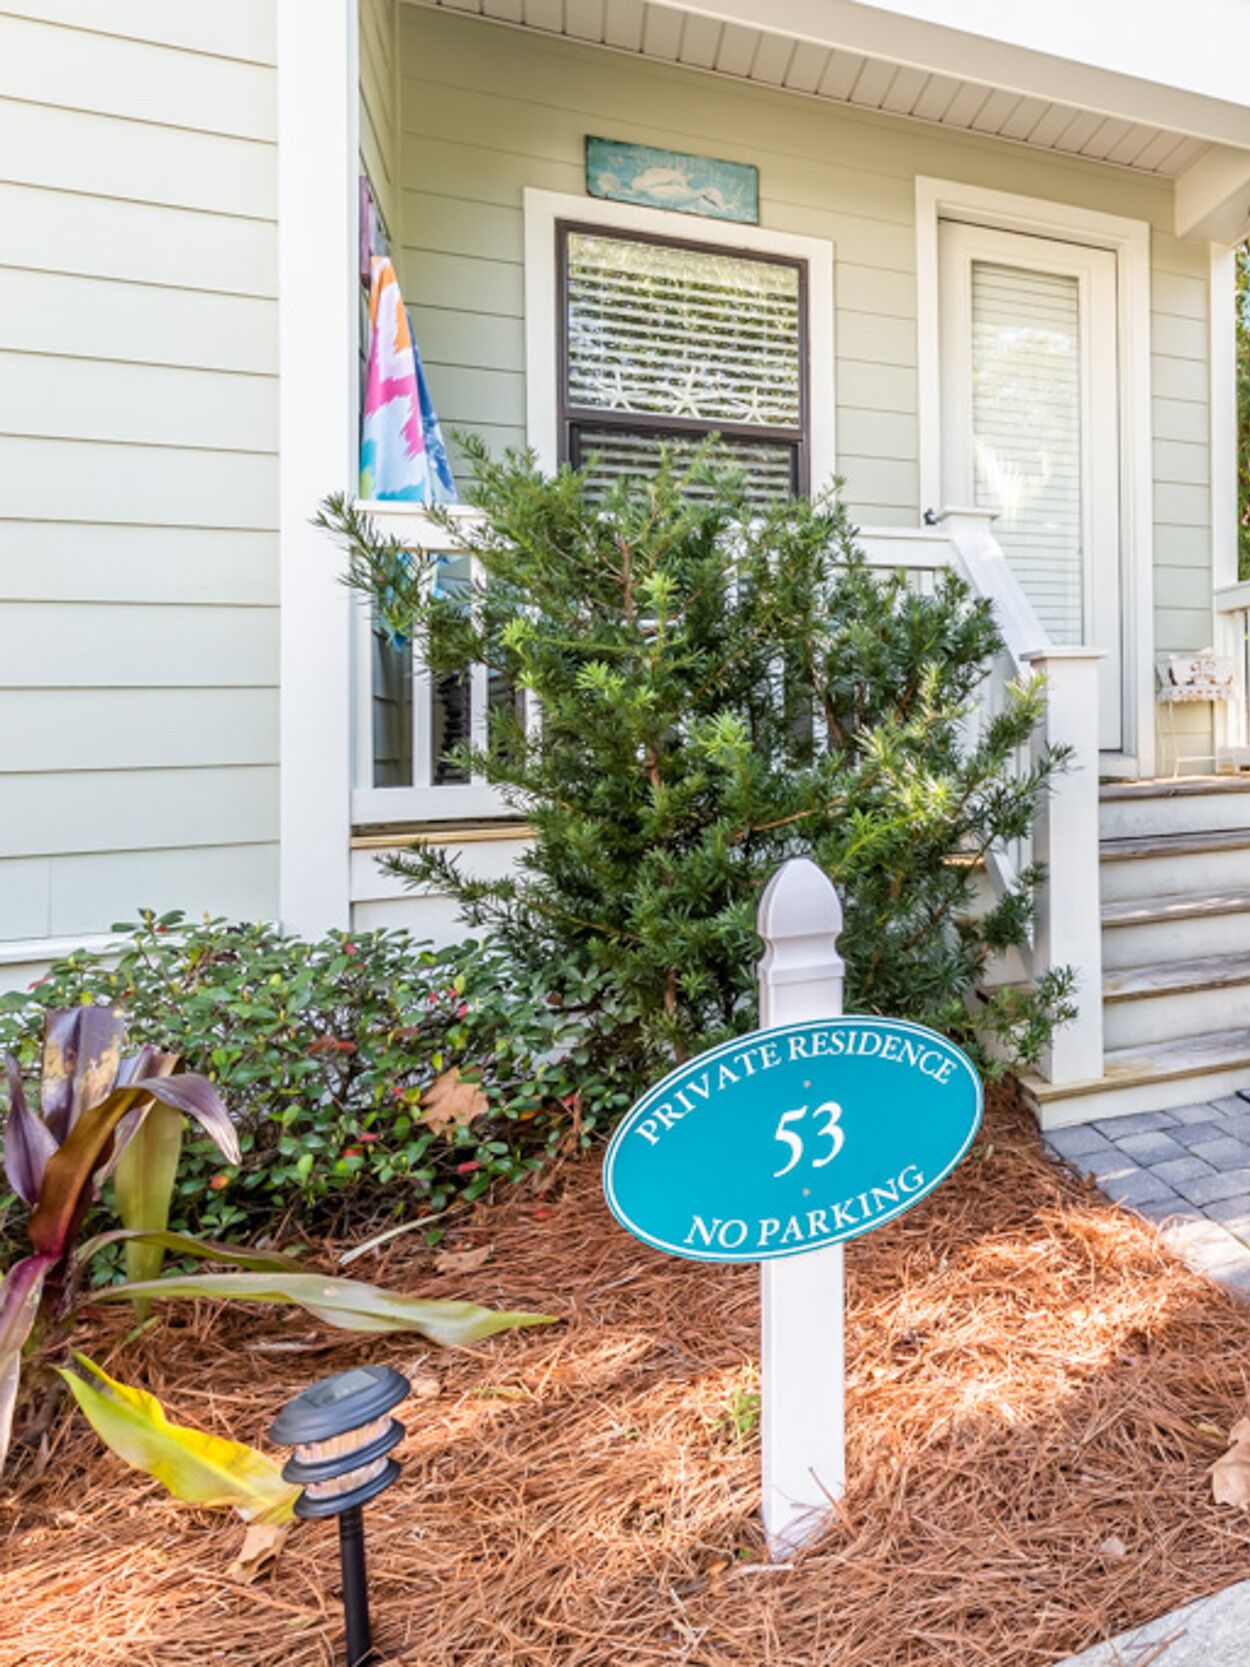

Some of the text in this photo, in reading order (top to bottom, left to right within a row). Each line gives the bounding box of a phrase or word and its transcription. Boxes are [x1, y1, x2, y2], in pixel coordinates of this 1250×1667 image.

[634, 1030, 958, 1146] PRIVATE RESIDENCE
[772, 1101, 846, 1178] 53
[683, 1163, 925, 1248] NO PARKING
